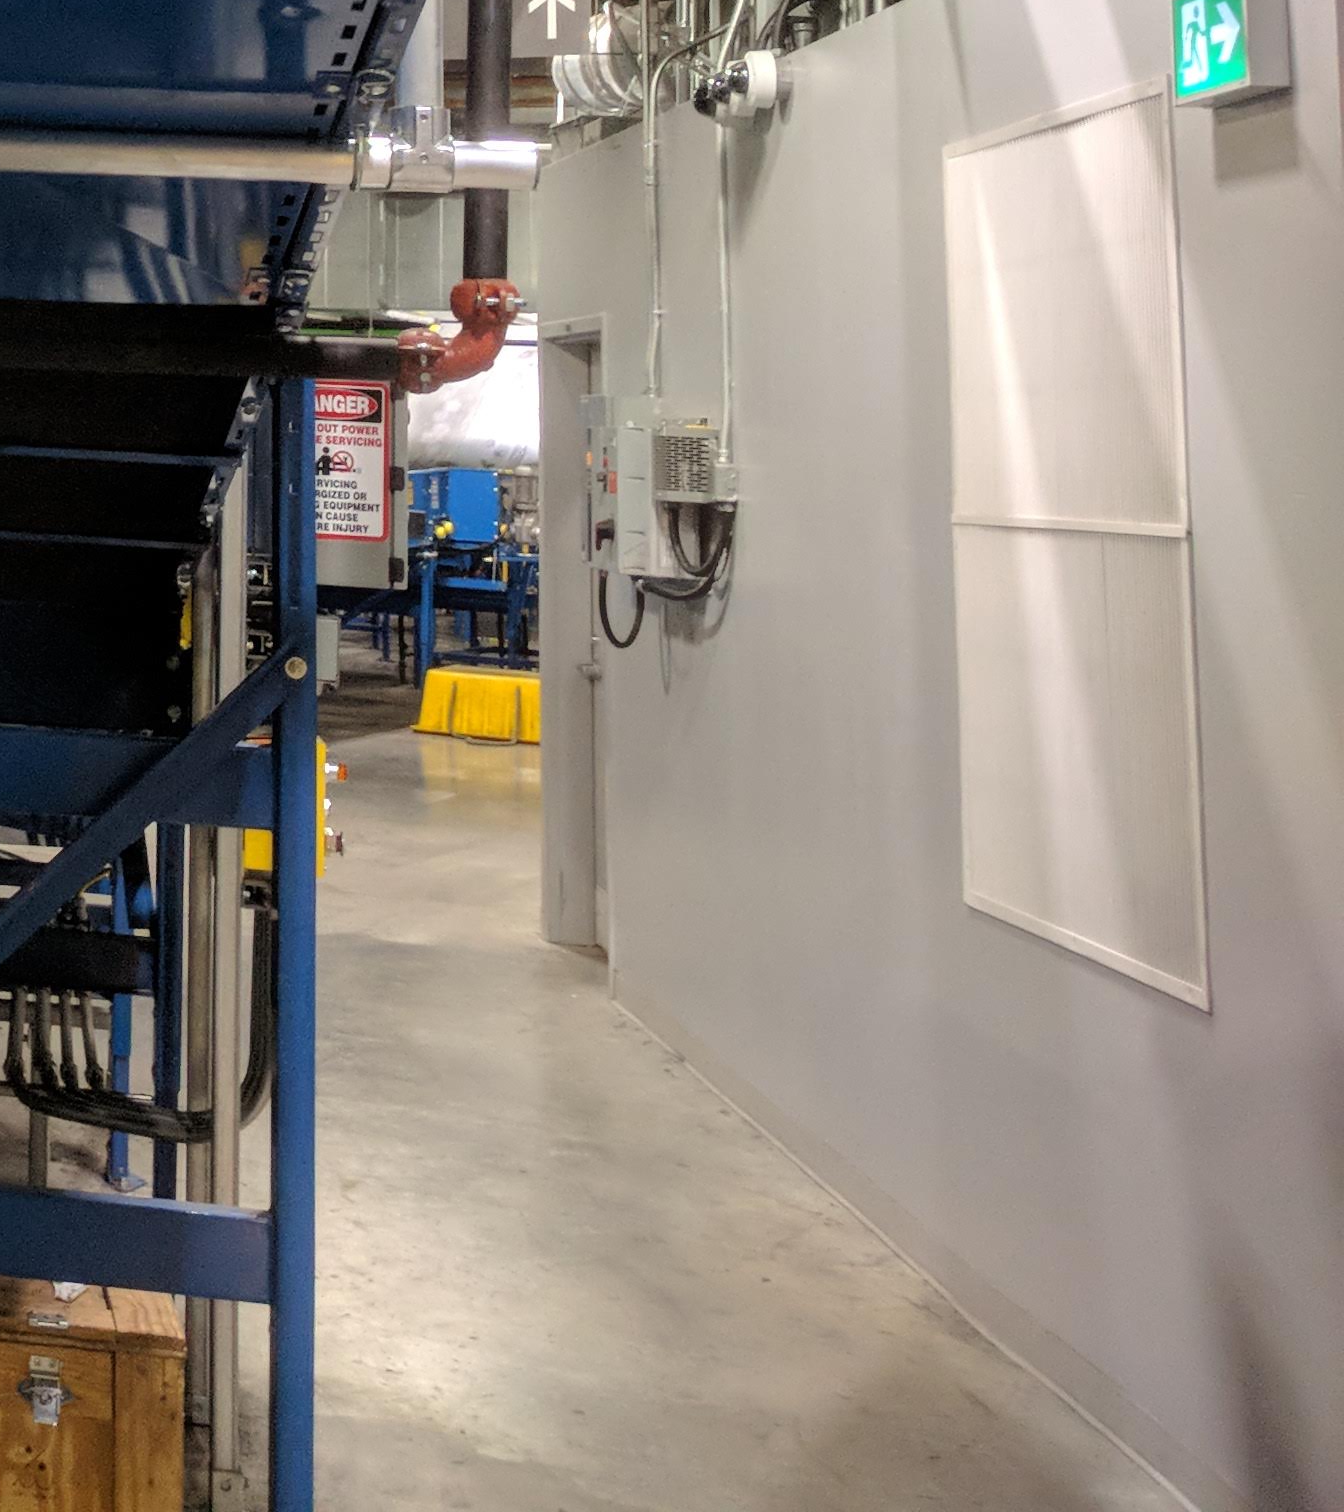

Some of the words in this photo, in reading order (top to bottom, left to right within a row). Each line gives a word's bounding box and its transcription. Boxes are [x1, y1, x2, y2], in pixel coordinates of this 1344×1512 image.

[317, 423, 338, 433] OUT
[342, 425, 379, 435] POWER
[325, 436, 382, 447] SERVICING
[317, 479, 357, 489] RVICING
[316, 490, 350, 499] RGIZED
[353, 492, 367, 500] OR
[324, 501, 380, 512] EQUIPMENT
[326, 513, 359, 521] CAUSE
[333, 523, 369, 533] INJURY
